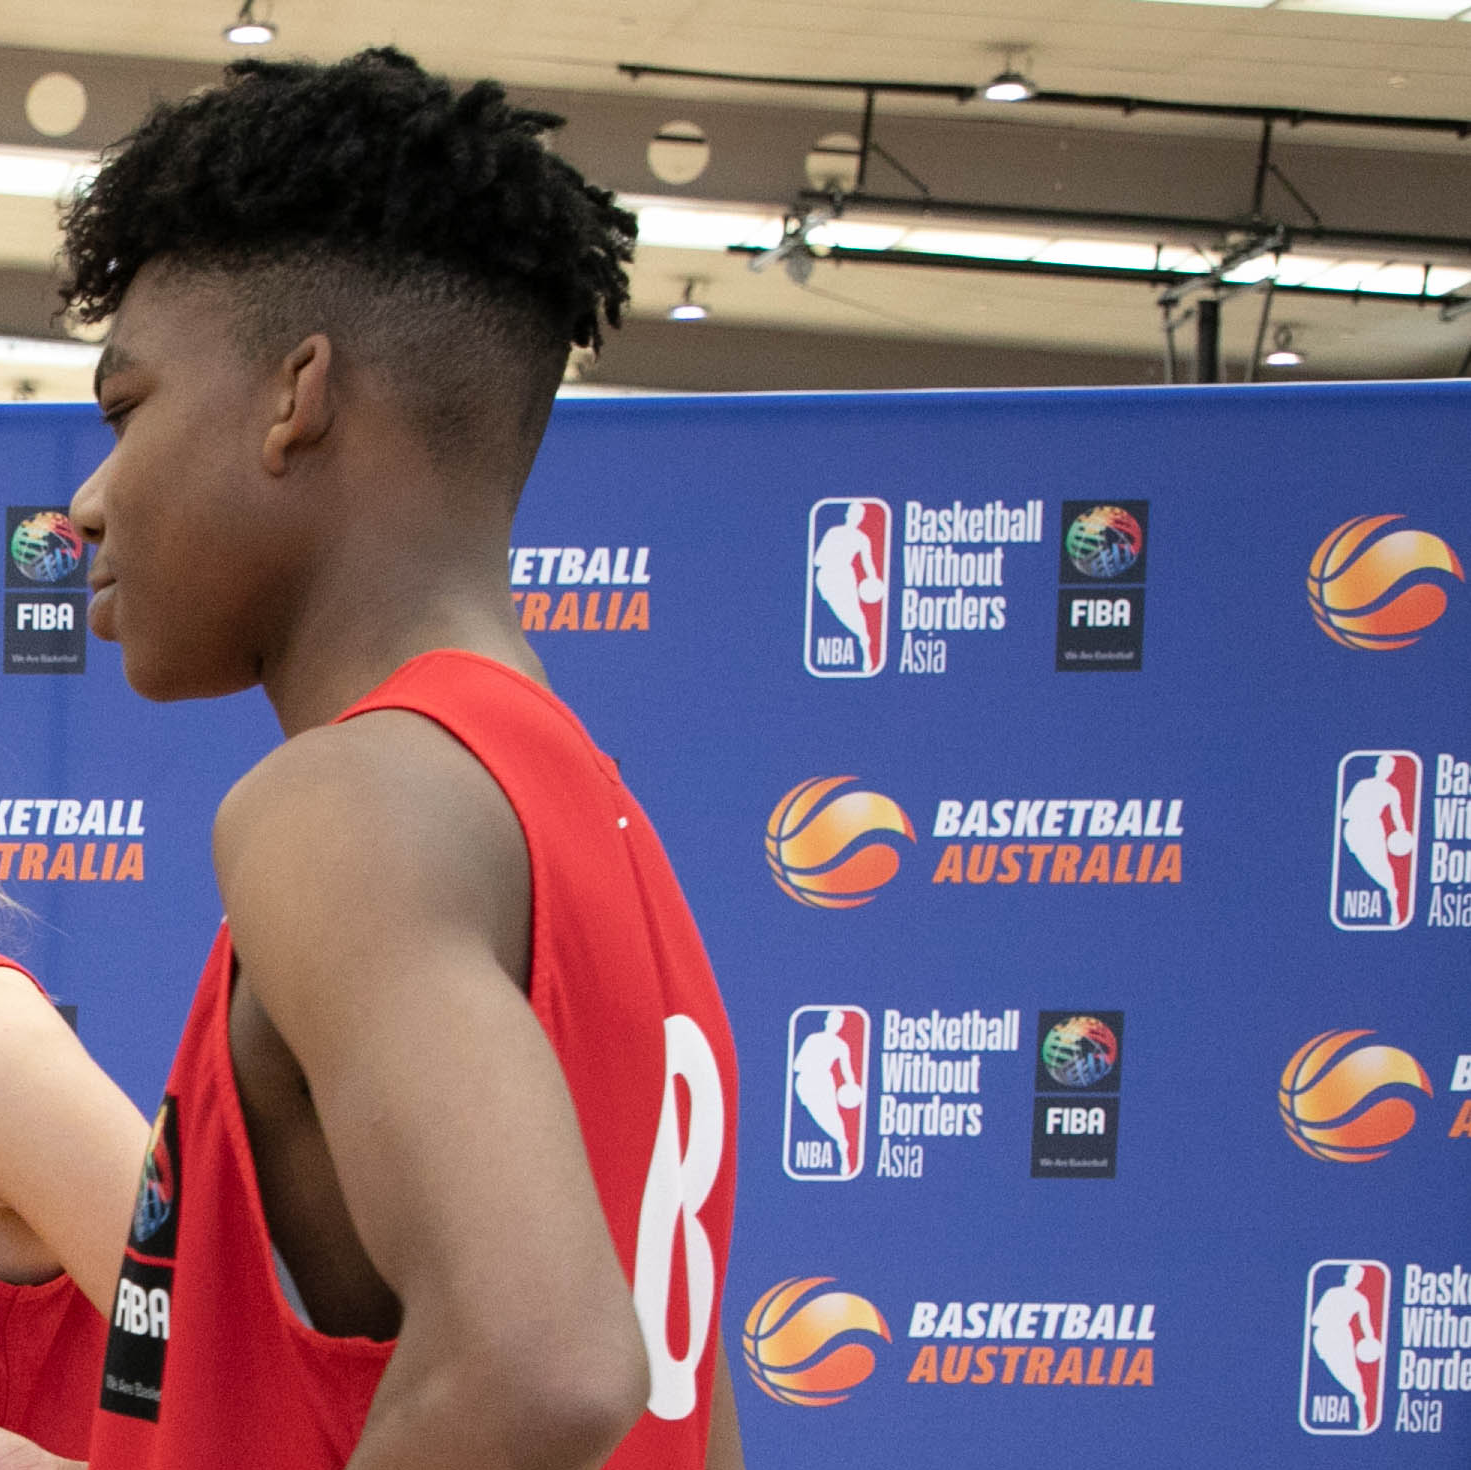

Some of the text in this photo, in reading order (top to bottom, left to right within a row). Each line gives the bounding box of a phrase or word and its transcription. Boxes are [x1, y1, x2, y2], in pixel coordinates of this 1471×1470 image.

[905, 500, 1043, 543] Basketball
[509, 548, 650, 584] ETBALL
[904, 545, 1003, 586] Without
[18, 603, 73, 630] FIBA
[902, 588, 1006, 630] Borders
[1072, 599, 1130, 626] FIBA
[818, 637, 854, 664] NBA
[900, 632, 946, 673] Asia
[934, 800, 1183, 836] BASKETBALL
[933, 845, 1181, 883] AUSTRALIA
[1344, 891, 1382, 917] NBA
[1428, 885, 1471, 927] Asia
[884, 1010, 1019, 1050] Basketball
[882, 1053, 980, 1093] Without
[880, 1095, 982, 1136] Borders
[1047, 1108, 1105, 1134] FIBA
[796, 1142, 832, 1168] NBA
[877, 1137, 923, 1177] Asia
[909, 1302, 1155, 1340] BASKETBALL
[907, 1346, 1152, 1386] AUSTRALIA
[1313, 1396, 1350, 1422] NBA
[1396, 1392, 1442, 1432] Asia
